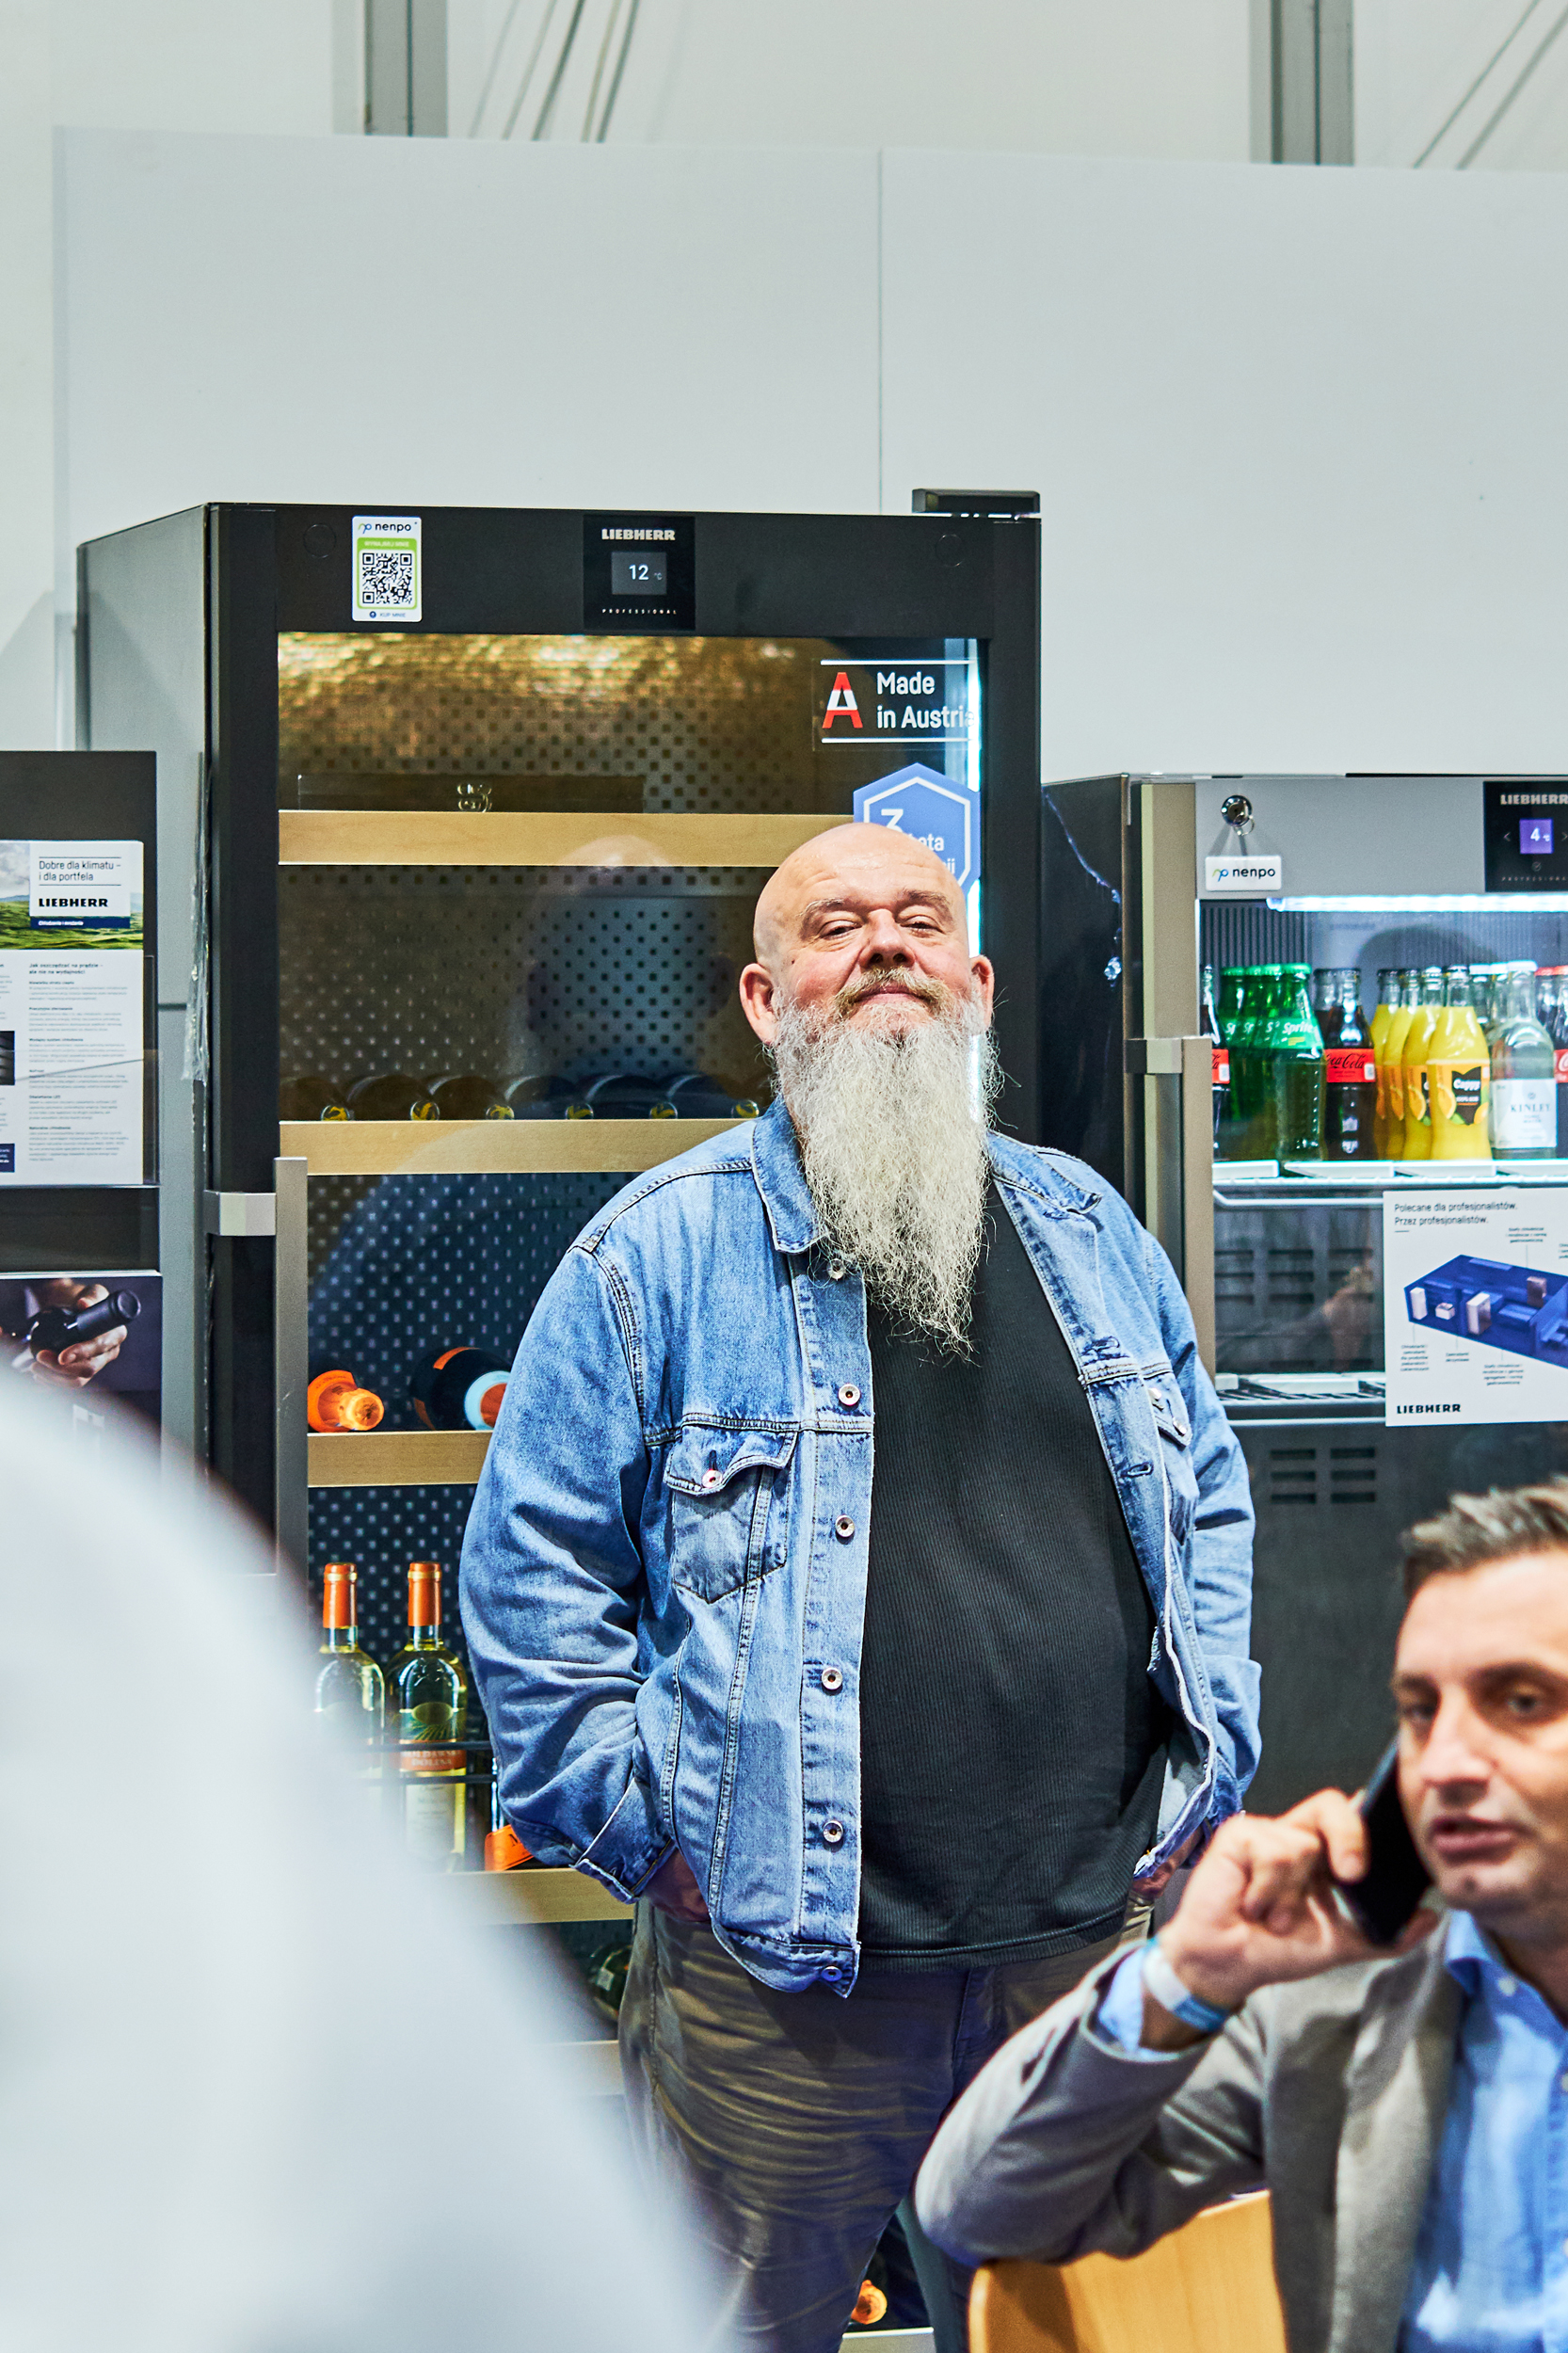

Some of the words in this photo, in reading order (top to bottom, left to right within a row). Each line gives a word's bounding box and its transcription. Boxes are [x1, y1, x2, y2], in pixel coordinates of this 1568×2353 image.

[375, 523, 411, 533] nenpo
[601, 528, 676, 541] LIEBHERR
[629, 564, 649, 581] 12
[876, 671, 936, 696] Made
[876, 705, 896, 729] in
[1499, 793, 1568, 805] LIEBHERR
[1529, 826, 1541, 841] 4
[39, 860, 65, 870] Dobre
[66, 860, 80, 870] dla
[82, 860, 114, 870] klimatu
[43, 872, 56, 881] dla
[58, 872, 94, 882] portfela
[1232, 868, 1276, 879] nenpo
[39, 898, 108, 907] LIEBHERR
[1282, 1020, 1314, 1035] Sprite
[1511, 1103, 1551, 1112] KINLEY
[1394, 1203, 1432, 1213] Polecane
[1434, 1203, 1447, 1212] dla
[1448, 1201, 1518, 1213] profesjonalistów.
[1394, 1216, 1417, 1226] Przez
[1418, 1215, 1489, 1227] profesjonalistów.
[1396, 1403, 1462, 1415] LIEBHERR
